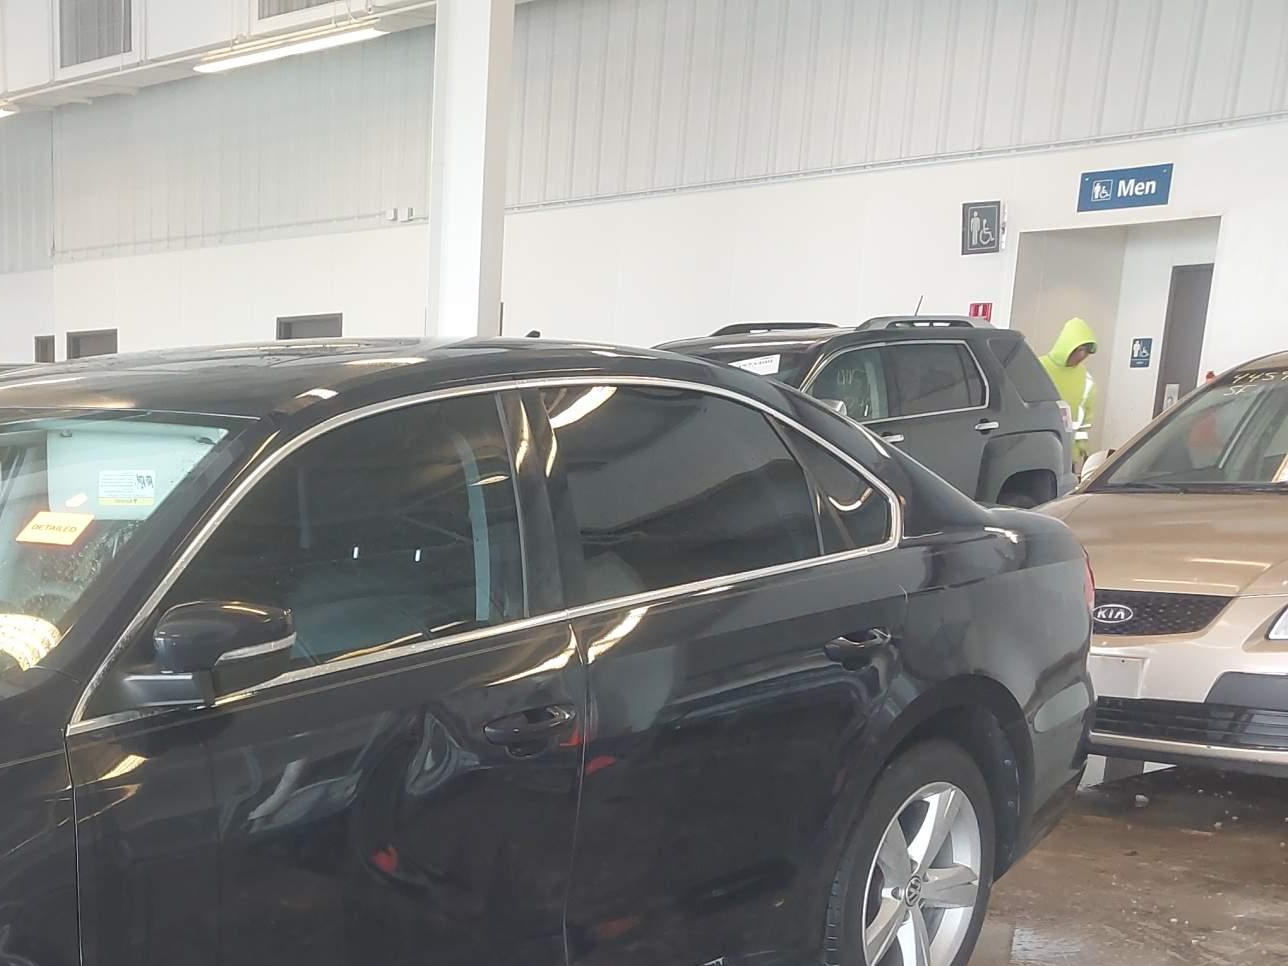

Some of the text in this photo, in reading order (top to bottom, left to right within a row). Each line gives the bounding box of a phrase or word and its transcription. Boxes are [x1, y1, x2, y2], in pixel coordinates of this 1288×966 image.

[1117, 178, 1156, 198] Men
[31, 524, 78, 533] DETAILED
[1097, 608, 1125, 619] KIA
